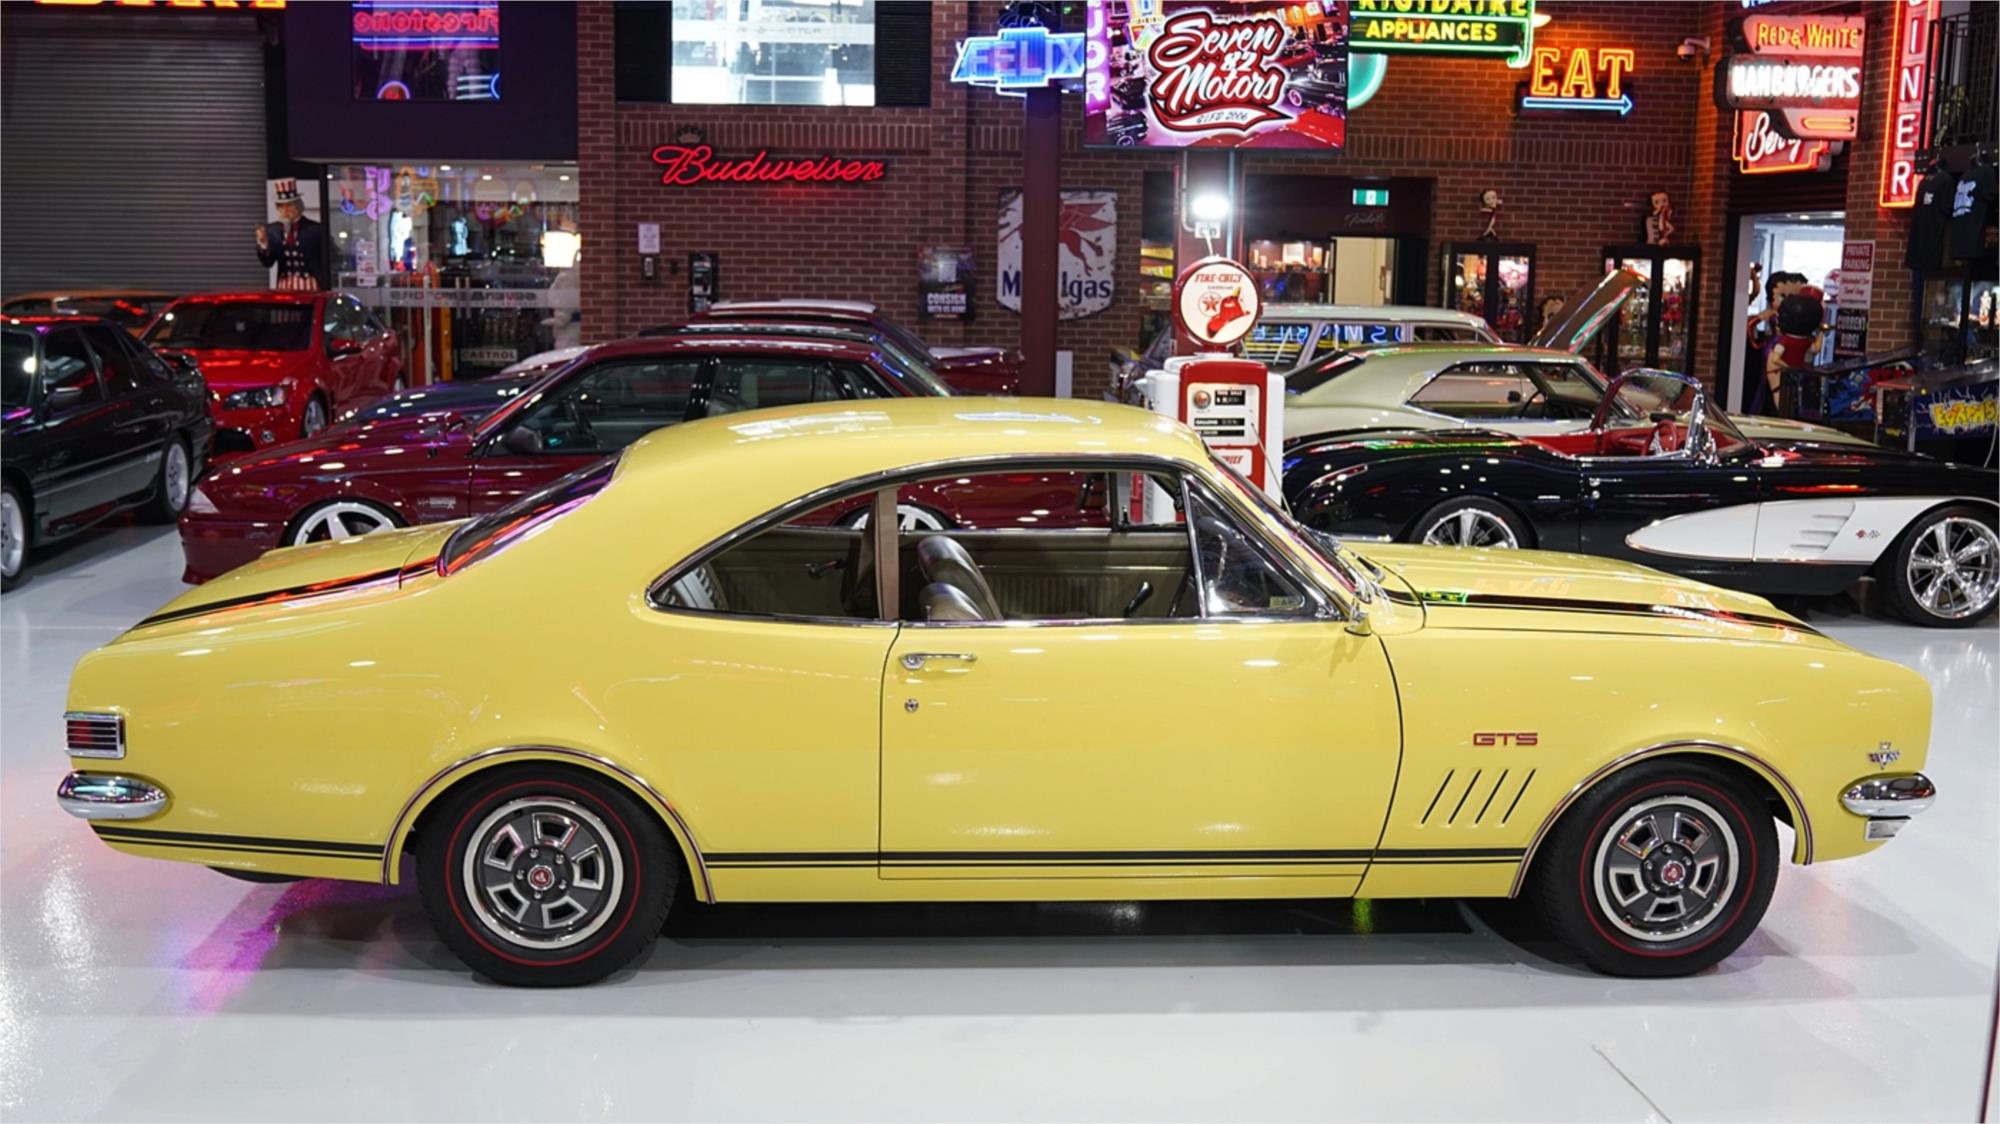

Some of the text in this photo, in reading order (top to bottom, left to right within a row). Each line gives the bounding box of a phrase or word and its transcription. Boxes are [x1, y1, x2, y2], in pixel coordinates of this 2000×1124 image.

[1154, 18, 1278, 69] Seven
[1366, 20, 1498, 41] APPLIANCES
[1758, 24, 1788, 46] RED
[1807, 24, 1859, 48] WHITE
[968, 39, 1085, 77] FELIX
[1220, 52, 1260, 72] 82
[1531, 48, 1634, 98] EAT
[1154, 63, 1281, 113] Motors
[1732, 65, 1860, 98] HAMBURGERS
[1892, 0, 1921, 195] INER
[652, 145, 887, 185] Budweiser
[1473, 732, 1538, 746] GTS
